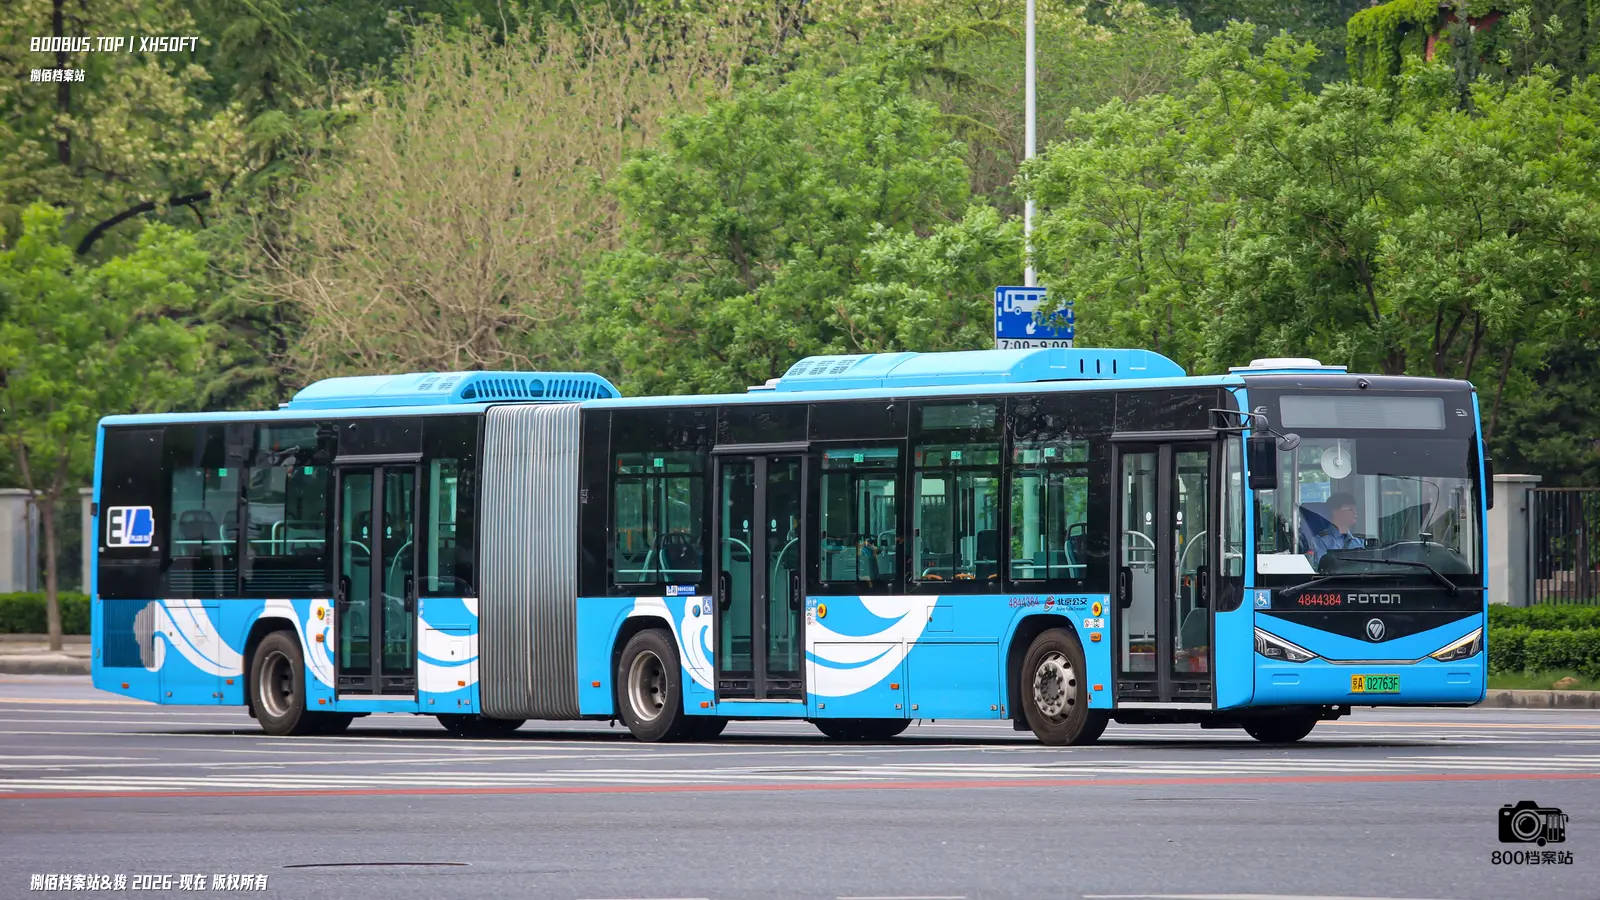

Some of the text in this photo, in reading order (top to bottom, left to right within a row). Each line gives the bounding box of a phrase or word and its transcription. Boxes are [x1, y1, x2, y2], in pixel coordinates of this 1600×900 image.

[1008, 596, 1039, 608] 4844384
[1057, 597, 1088, 605] 北京公交
[1298, 594, 1341, 606] 4844384
[1347, 593, 1401, 604] FOTON
